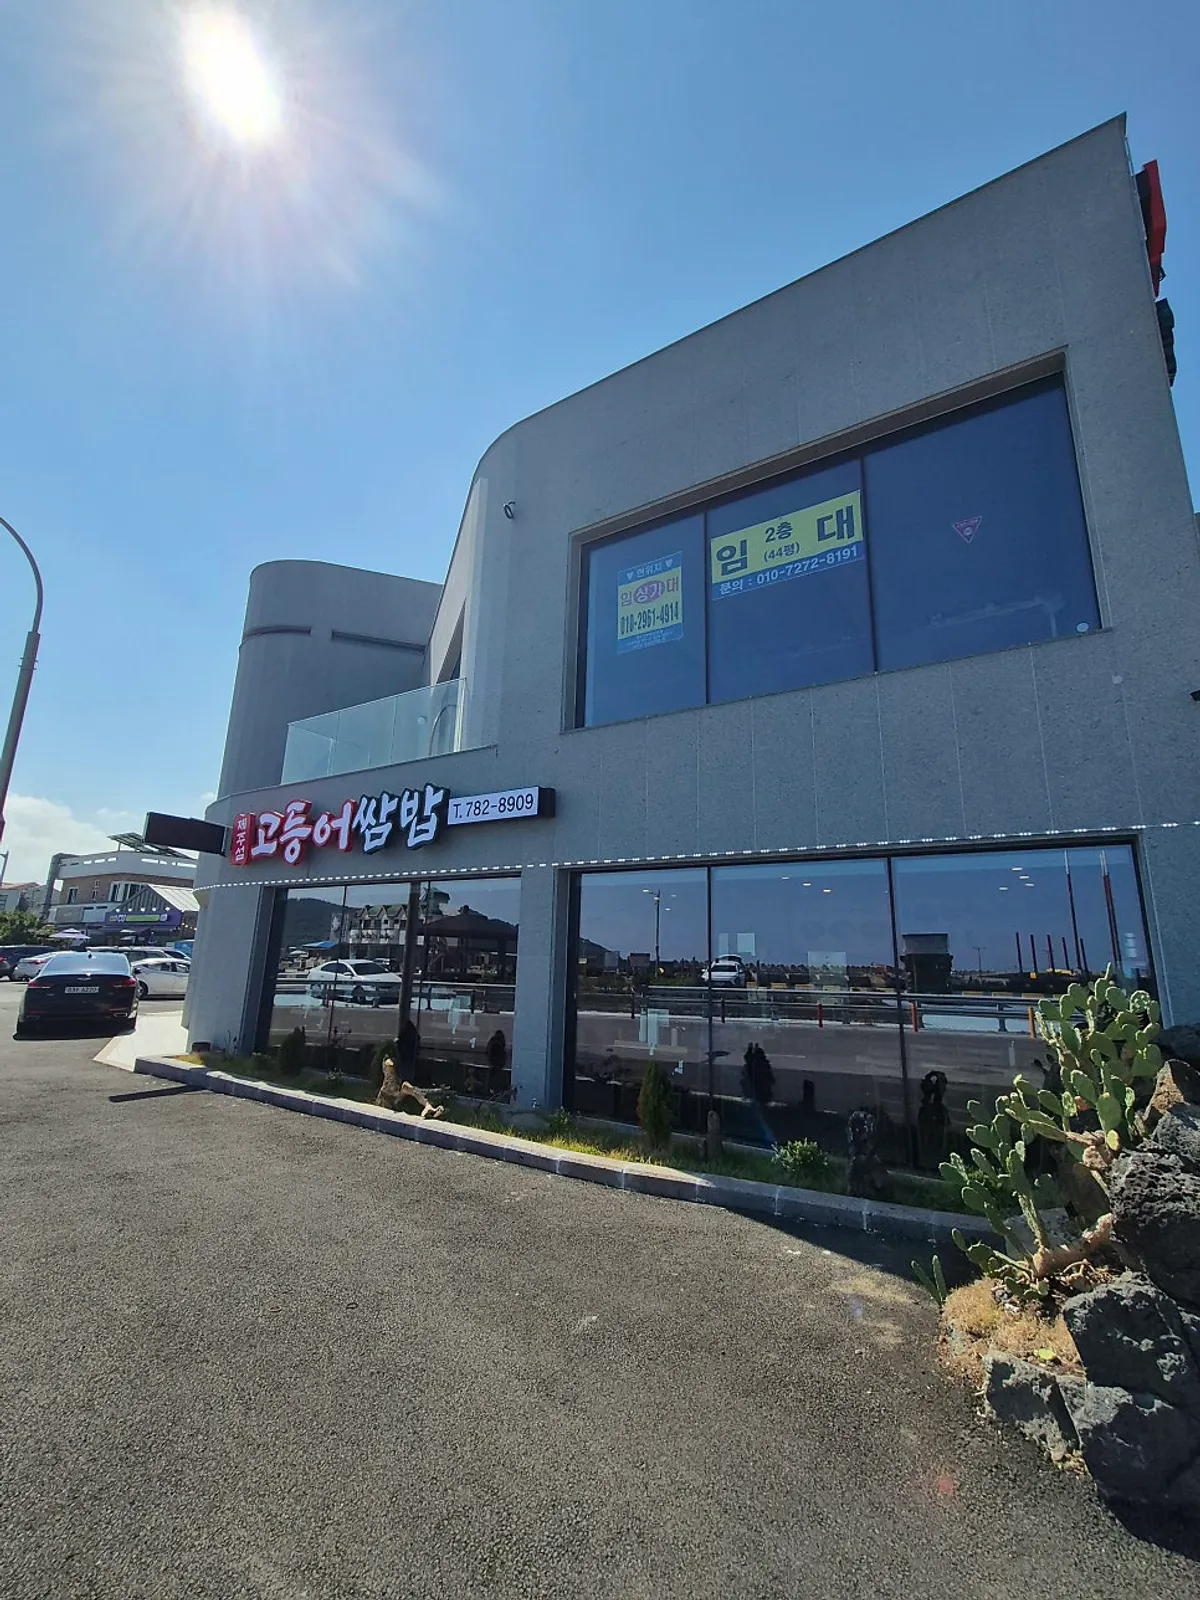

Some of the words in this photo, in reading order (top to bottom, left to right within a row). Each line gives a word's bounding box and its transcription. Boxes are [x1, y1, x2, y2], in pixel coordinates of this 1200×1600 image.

[716, 539, 747, 576] 임
[817, 505, 855, 542] 대
[763, 542, 800, 562] (44평)
[765, 521, 793, 543] 2층
[719, 578, 743, 594] 문의
[756, 545, 858, 585] 010-7272-8191
[235, 817, 247, 861] 제주섬
[251, 784, 444, 864] 고등어쌈밥
